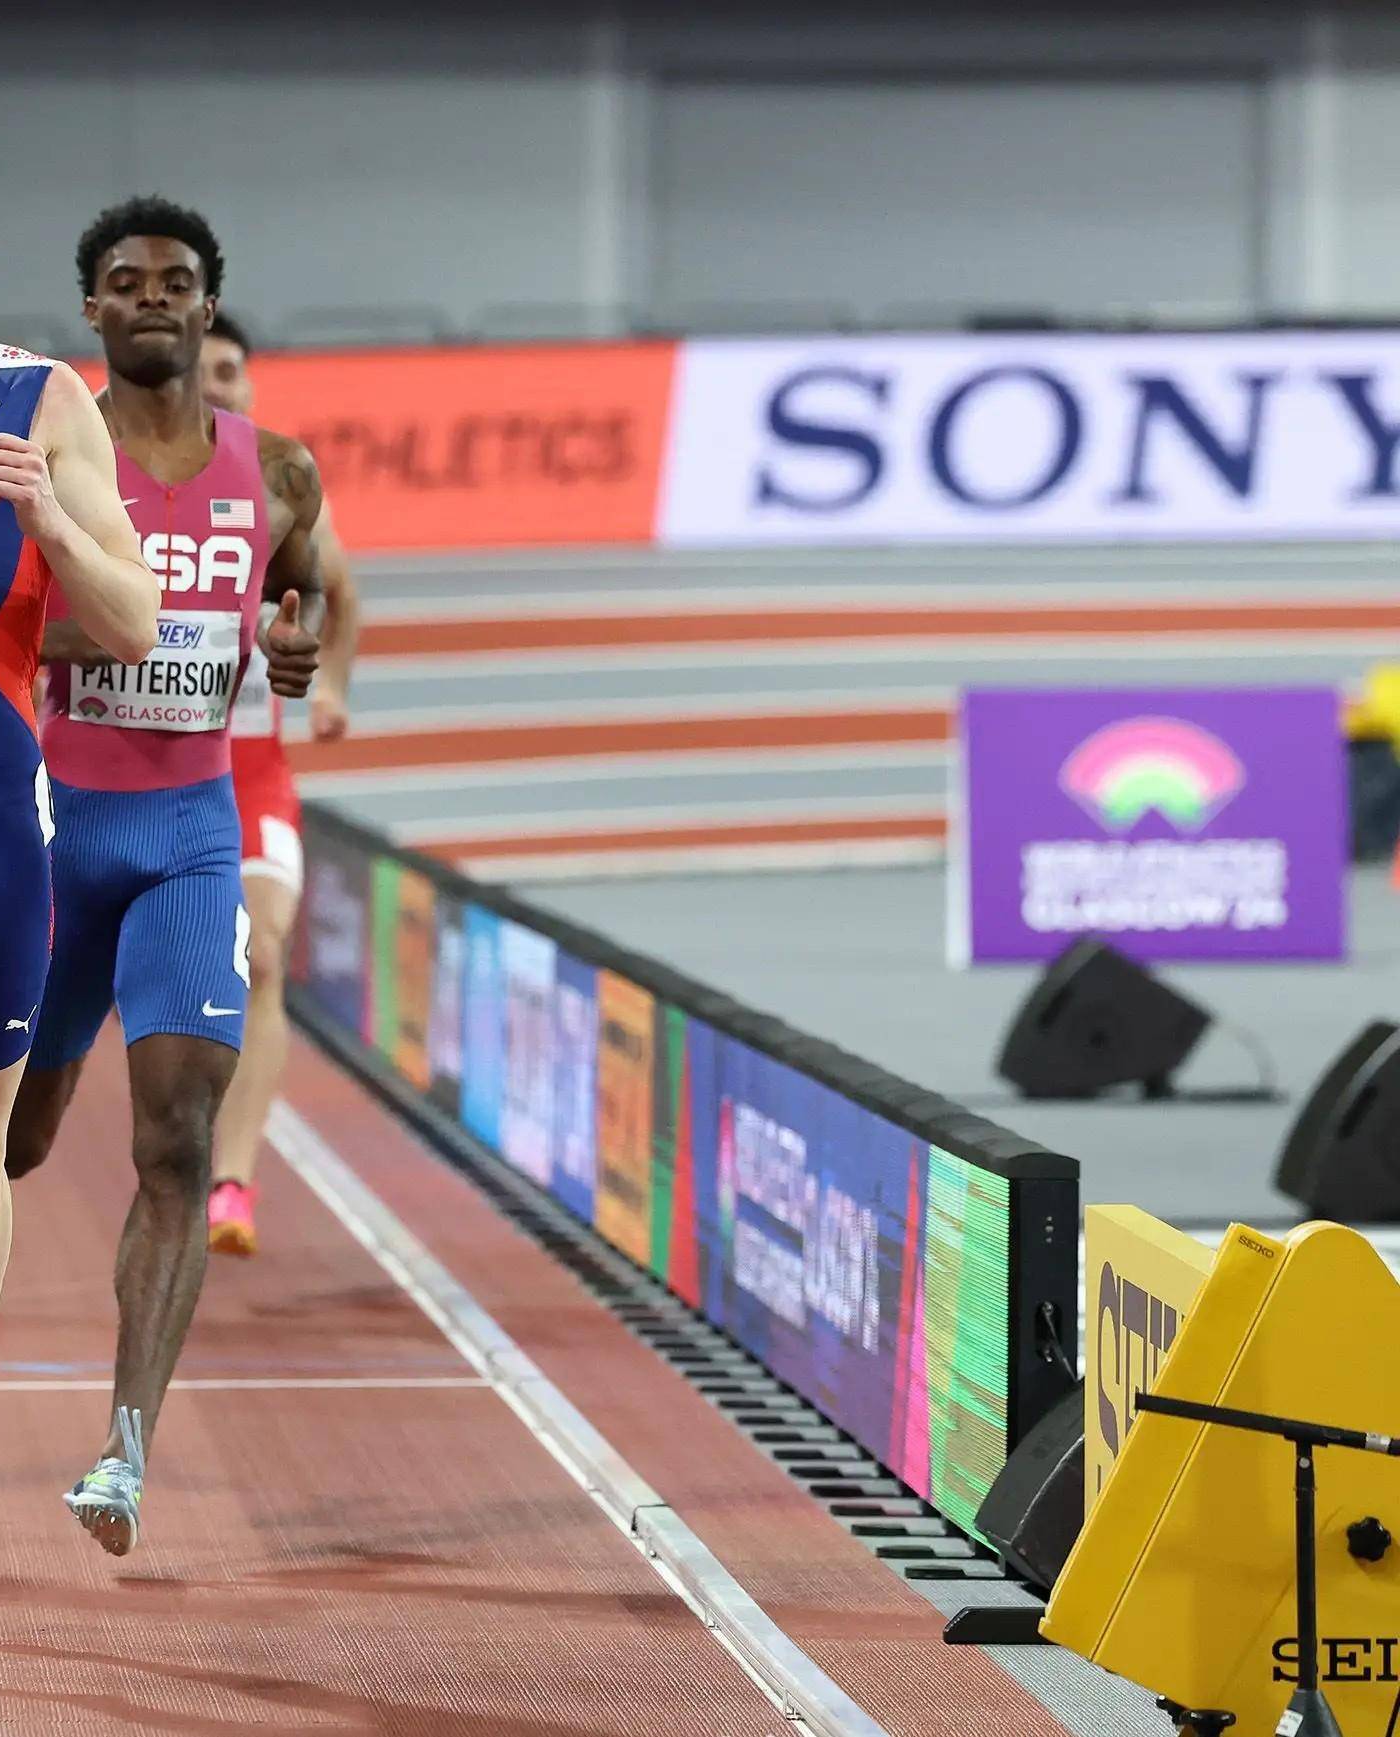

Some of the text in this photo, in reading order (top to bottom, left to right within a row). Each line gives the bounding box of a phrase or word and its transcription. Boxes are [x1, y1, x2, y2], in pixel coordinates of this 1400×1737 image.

[748, 364, 1400, 512] SONY
[135, 532, 253, 595] SA
[81, 660, 231, 697] PATTERSON
[115, 705, 206, 723] GLASGOW
[1238, 1234, 1275, 1258] SEIKO
